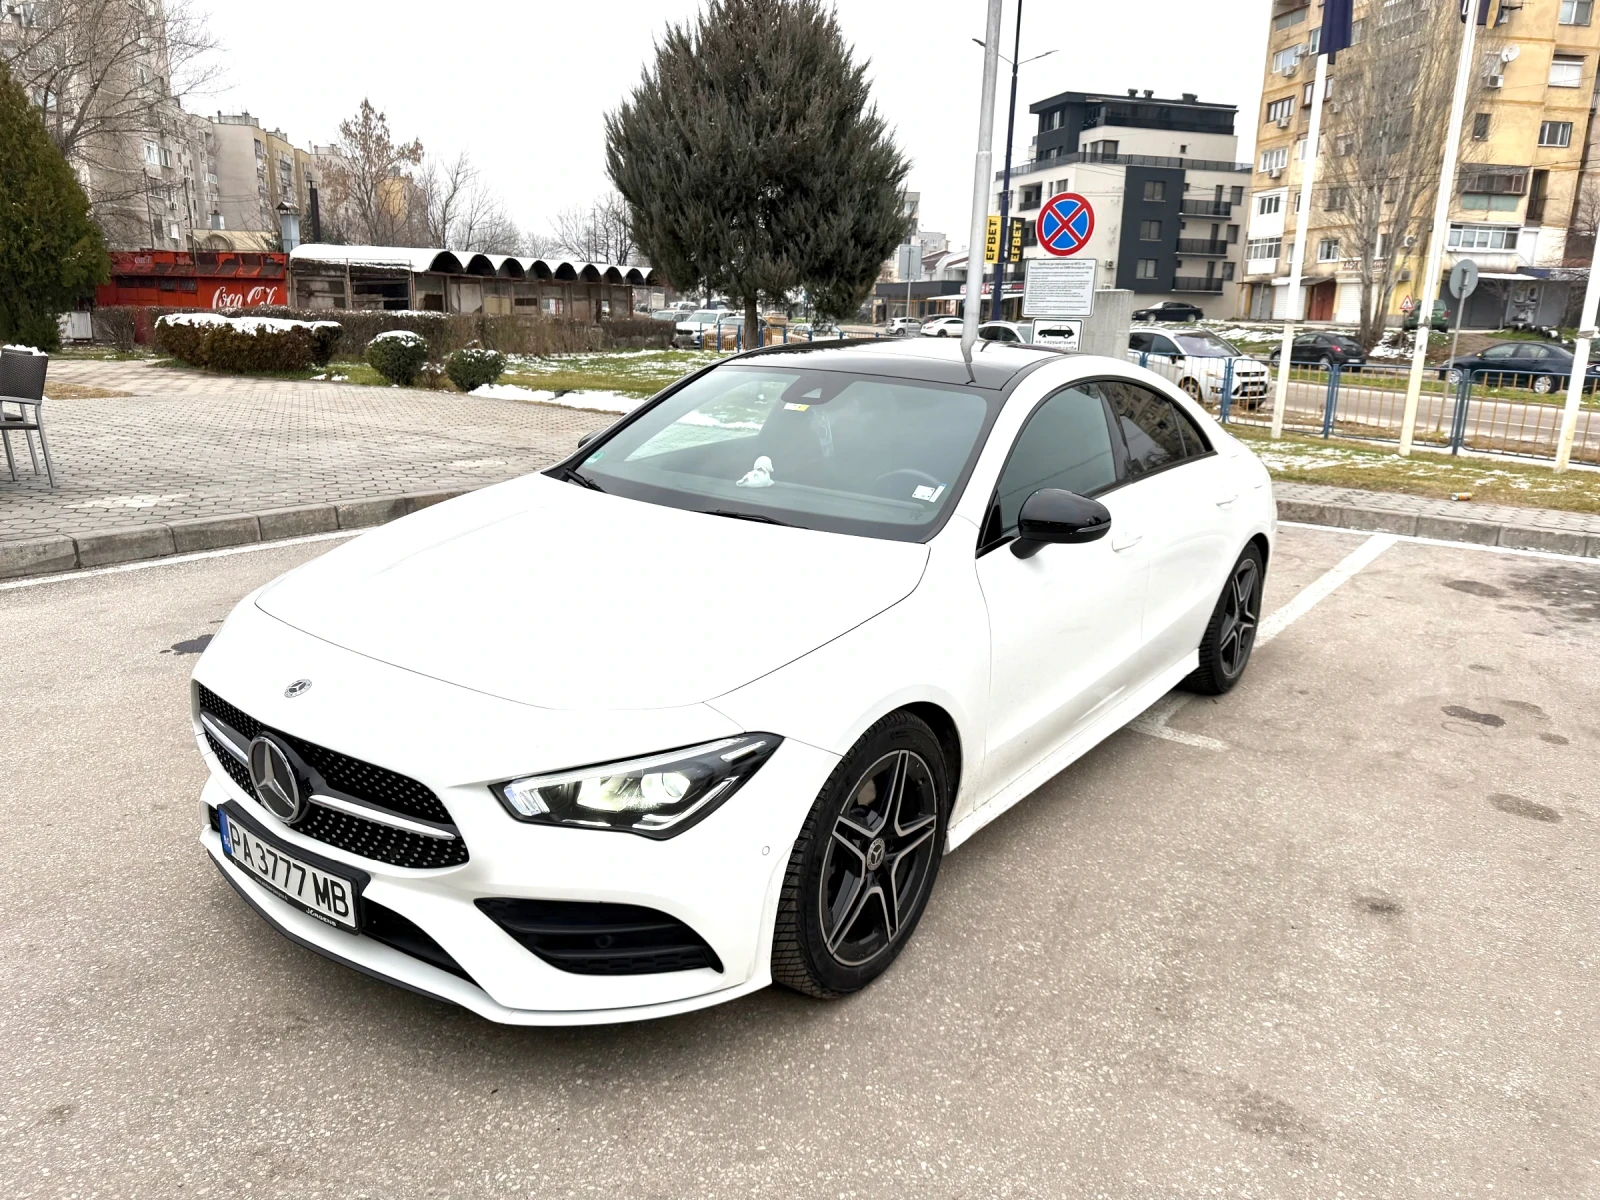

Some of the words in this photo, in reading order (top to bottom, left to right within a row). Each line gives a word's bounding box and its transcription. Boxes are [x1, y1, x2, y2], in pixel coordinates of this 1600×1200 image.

[986, 219, 998, 261] EFBET
[1010, 220, 1023, 262] EFBET
[212, 286, 243, 310] Coca
[255, 842, 306, 897] 3777
